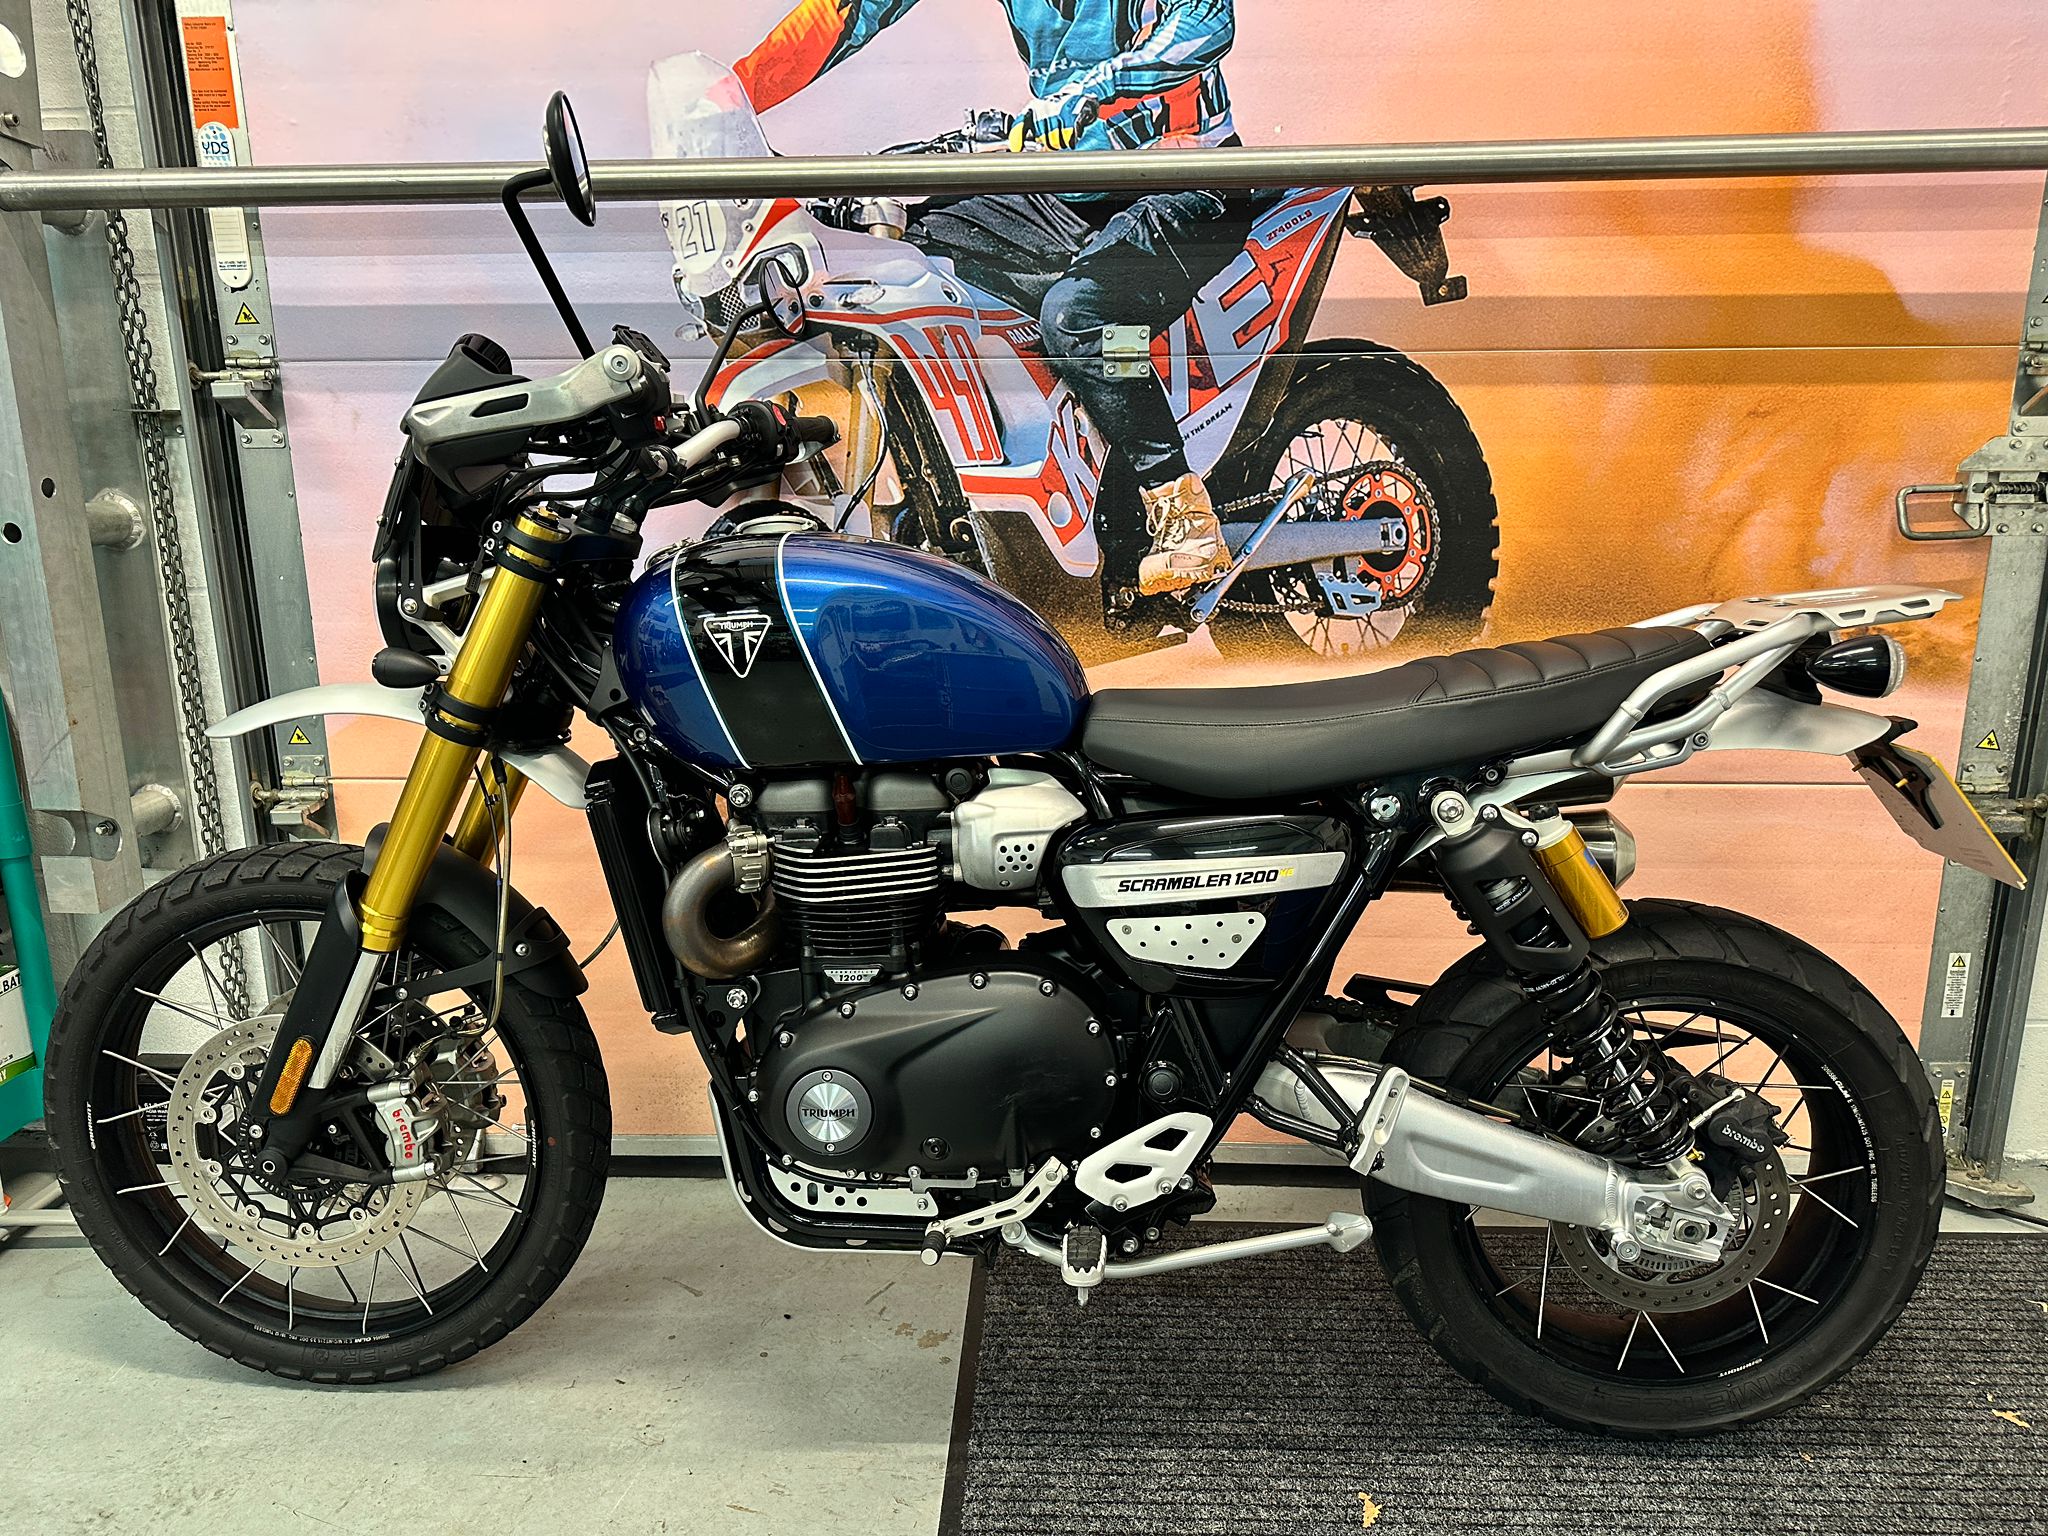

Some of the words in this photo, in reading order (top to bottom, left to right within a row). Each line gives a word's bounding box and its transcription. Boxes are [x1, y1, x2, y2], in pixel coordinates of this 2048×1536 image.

[202, 141, 230, 155] YDS
[676, 200, 716, 259] 21
[1205, 402, 1233, 426] DREAM
[719, 620, 754, 631] TRIUMPH
[1117, 873, 1232, 893] SCRAMBLER
[1234, 869, 1280, 886] 1200
[839, 974, 863, 982] 1200
[801, 1108, 855, 1121] TRIUMPH
[392, 1108, 416, 1159] brembo
[1721, 1123, 1765, 1153] brembo
